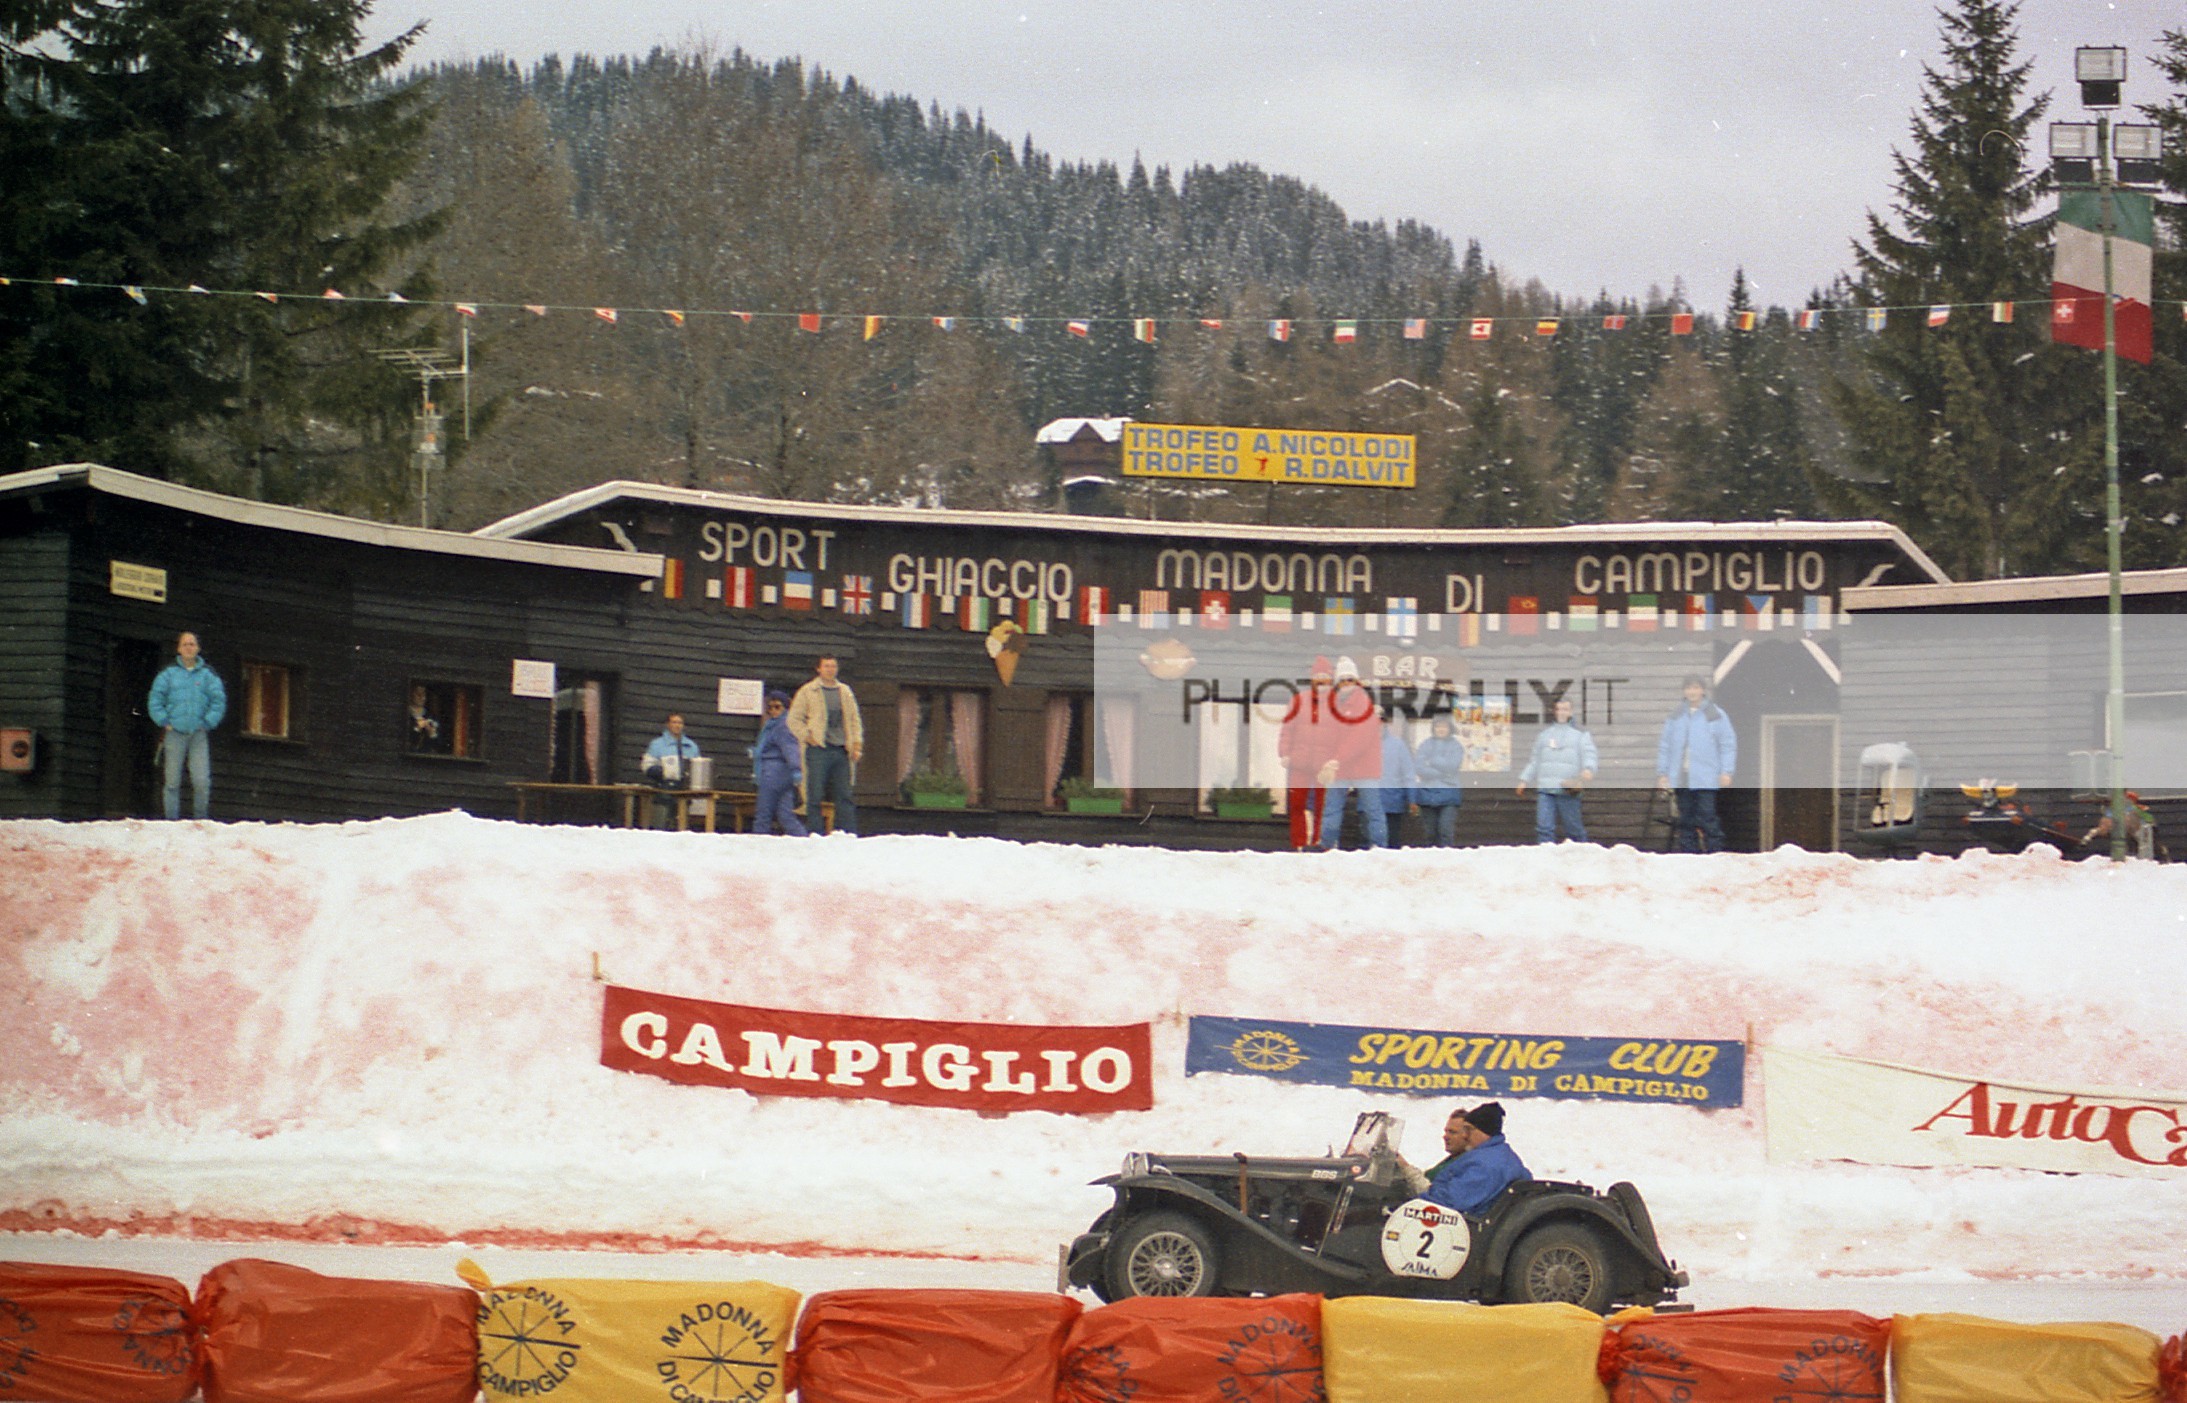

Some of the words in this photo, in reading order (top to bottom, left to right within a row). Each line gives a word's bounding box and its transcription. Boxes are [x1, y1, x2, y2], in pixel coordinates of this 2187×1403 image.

[1128, 427, 1239, 452] TROFEO
[1253, 433, 1411, 460] A.NICOLODI
[1128, 450, 1239, 475] TROFEO
[1285, 456, 1409, 482] R.DALVIT
[699, 521, 836, 571] SPORT
[888, 553, 1073, 602] GHIACCIO
[1156, 549, 1372, 593] MADONNA
[1446, 574, 1483, 613] DI
[1574, 551, 1825, 594] CAMPIGLIO
[1373, 655, 1438, 680] BAR
[620, 1011, 1133, 1094] CAMPIGLIO
[1348, 1033, 1566, 1070] SPORTING
[1607, 1041, 1719, 1078] CLUB
[1350, 1070, 1490, 1092] MADONNA
[1509, 1075, 1538, 1092] DI
[1555, 1076, 1709, 1101] CAMPIGLIO
[1404, 1208, 1458, 1226] MARTINI
[1416, 1230, 1434, 1259] 2
[661, 1301, 774, 1355] MADONNA
